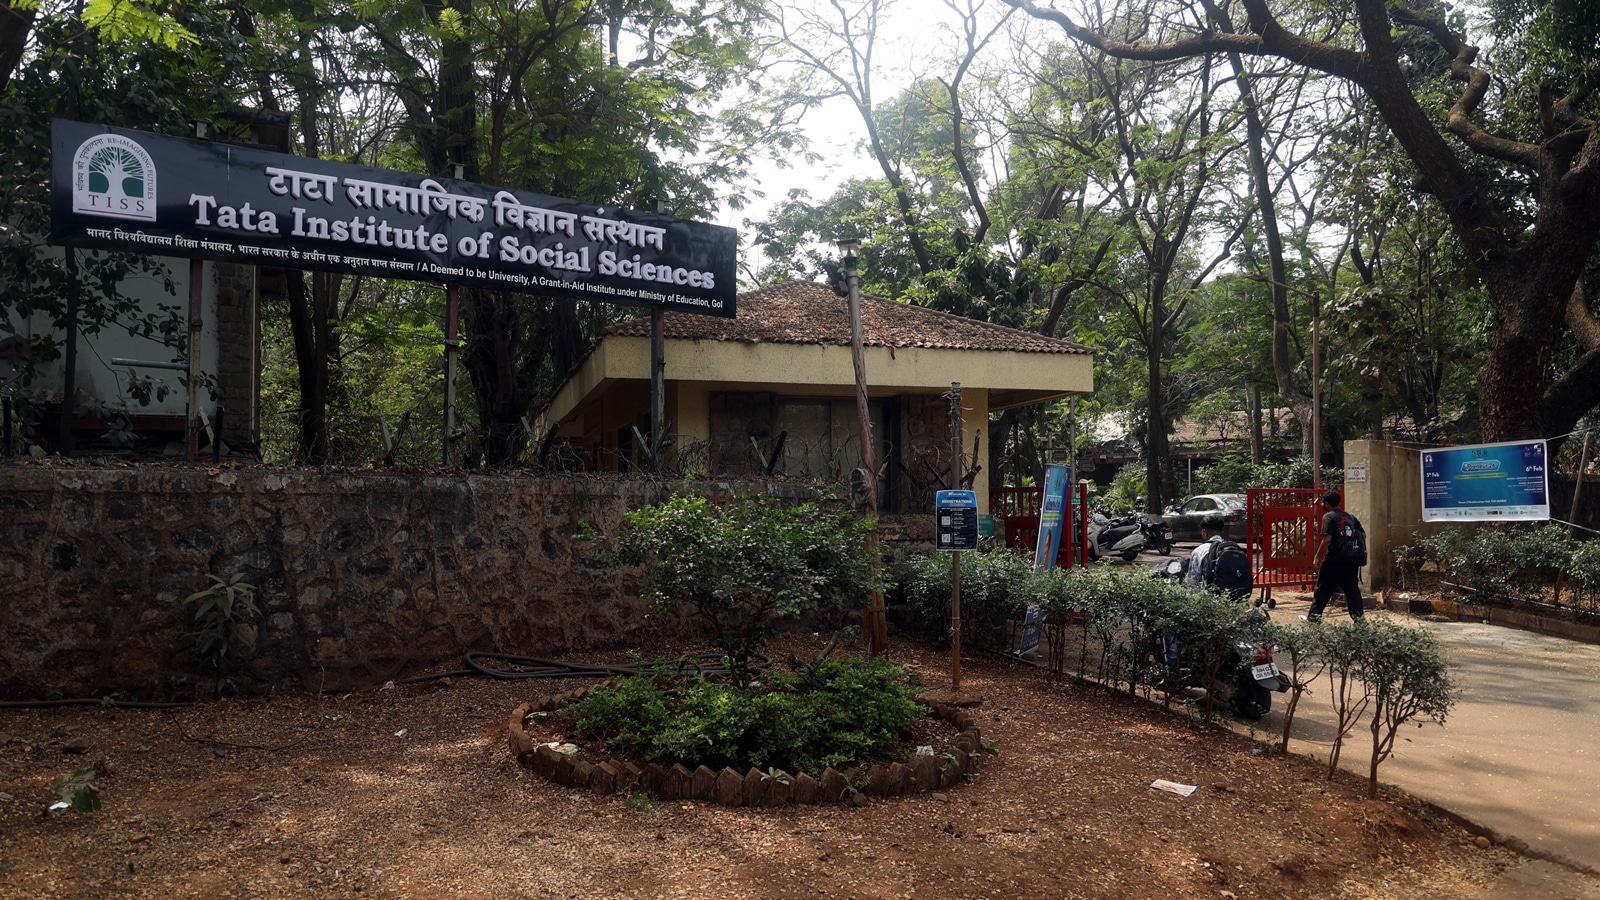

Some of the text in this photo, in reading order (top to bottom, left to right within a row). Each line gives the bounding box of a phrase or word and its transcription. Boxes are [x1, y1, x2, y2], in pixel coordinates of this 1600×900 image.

[107, 137, 152, 168] RE-IMAGINING
[88, 194, 145, 212] TISS
[188, 193, 715, 289] Tata Institute of Social Sciences
[265, 166, 667, 250] टाटा सामाजिक विज्ञान संस्थान
[86, 228, 111, 240] मानद
[113, 227, 173, 246] विश्वविद्यालय
[174, 235, 199, 248] शिक्षा
[238, 244, 260, 255] भारत
[262, 247, 289, 259] सरकार
[291, 246, 300, 259] के
[302, 251, 325, 262] अधीन
[327, 255, 341, 265] एक
[342, 256, 370, 268] अनुदान
[371, 259, 388, 268] प्राप्त
[389, 258, 414, 271] संस्थान
[416, 262, 421, 271] /
[421, 263, 429, 272] A
[430, 263, 464, 276] Deemed
[465, 268, 474, 277] to
[476, 268, 487, 279] be
[488, 270, 530, 286] University,
[531, 275, 538, 285] A
[539, 277, 585, 291] Grant-in-Aid
[586, 282, 616, 295] Institute
[617, 287, 638, 298] under
[639, 289, 666, 303] Ministry
[667, 293, 675, 302] of
[675, 294, 710, 308] Education,
